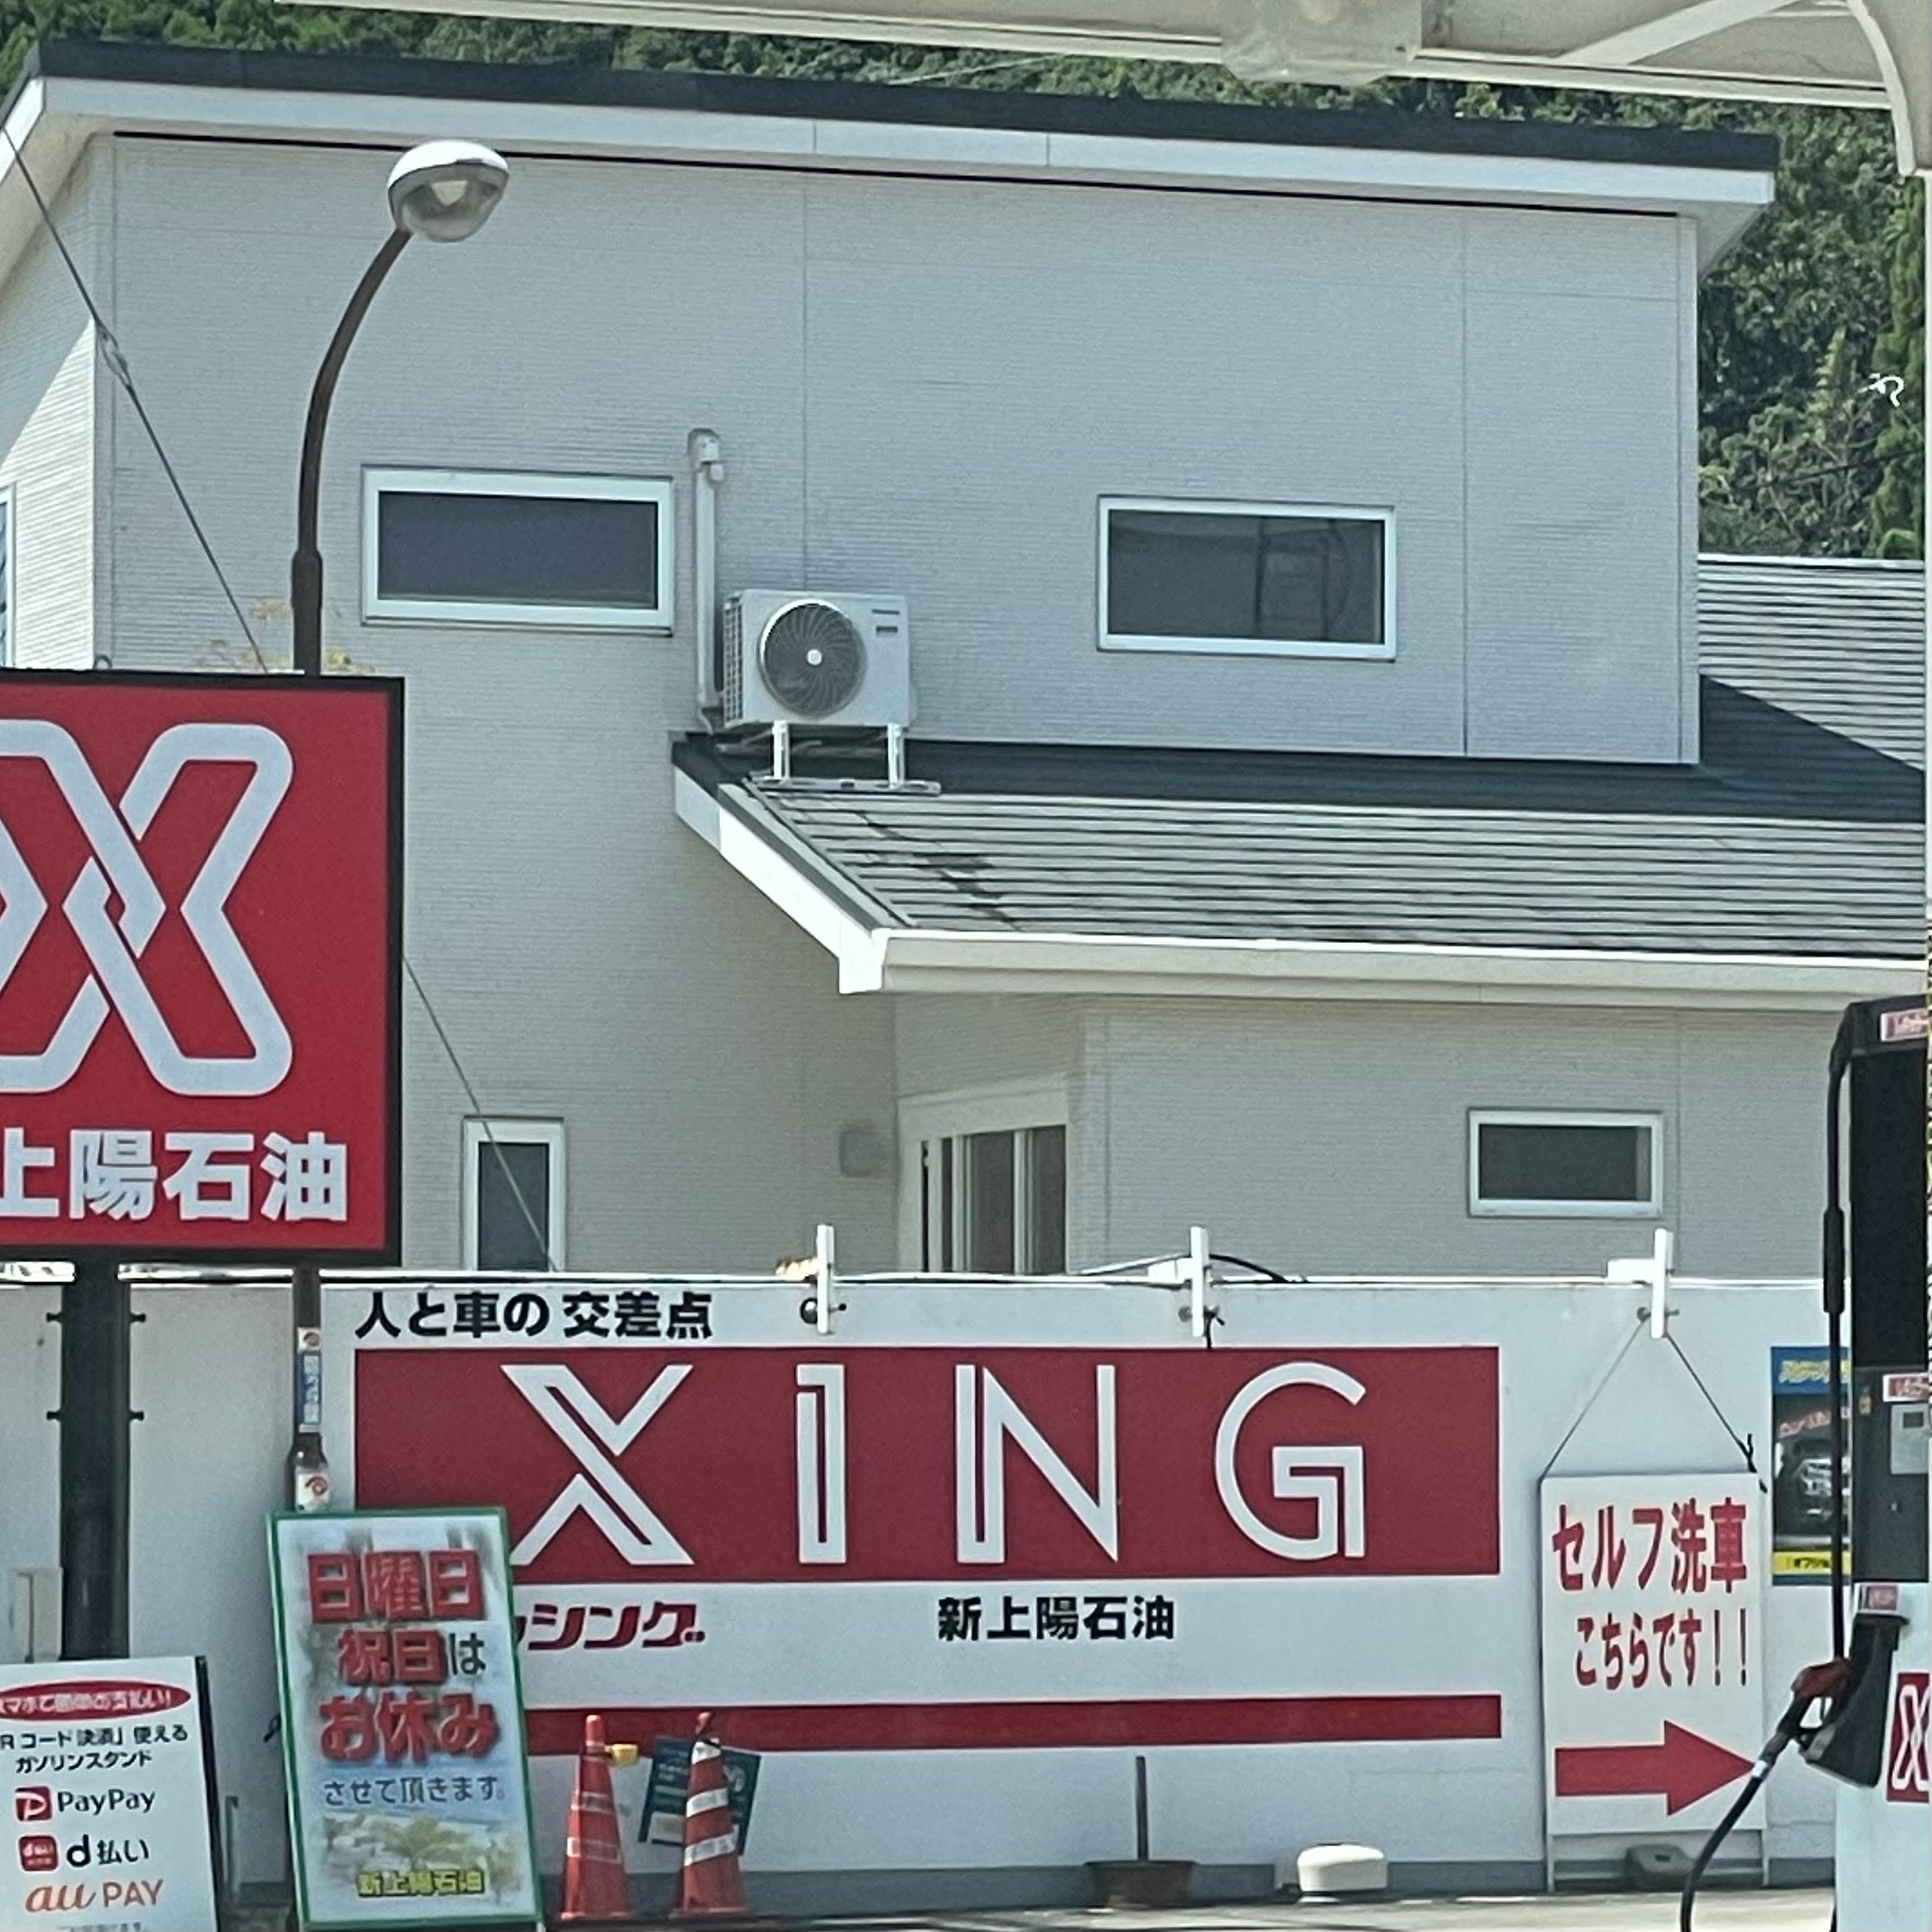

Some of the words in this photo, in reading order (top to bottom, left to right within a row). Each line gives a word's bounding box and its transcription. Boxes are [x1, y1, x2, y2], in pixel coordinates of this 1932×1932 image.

[0, 1127, 347, 1221] 上陽石油
[501, 1361, 1367, 1565] XING
[1552, 1497, 1747, 1594] セルフ洗車
[308, 1550, 487, 1623] 日曜日
[517, 1601, 705, 1650] シング
[937, 1595, 1175, 1642] 新上陽石油
[338, 1629, 486, 1685] 祝日は
[1576, 1608, 1746, 1690] こちらです!!
[320, 1690, 500, 1765] お休み
[16, 1750, 152, 1773] ガソリンスタンド
[57, 1789, 156, 1815] PayPay
[324, 1776, 505, 1806] させて頂きます。
[25, 1884, 97, 1913] au
[102, 1878, 164, 1908] PAY
